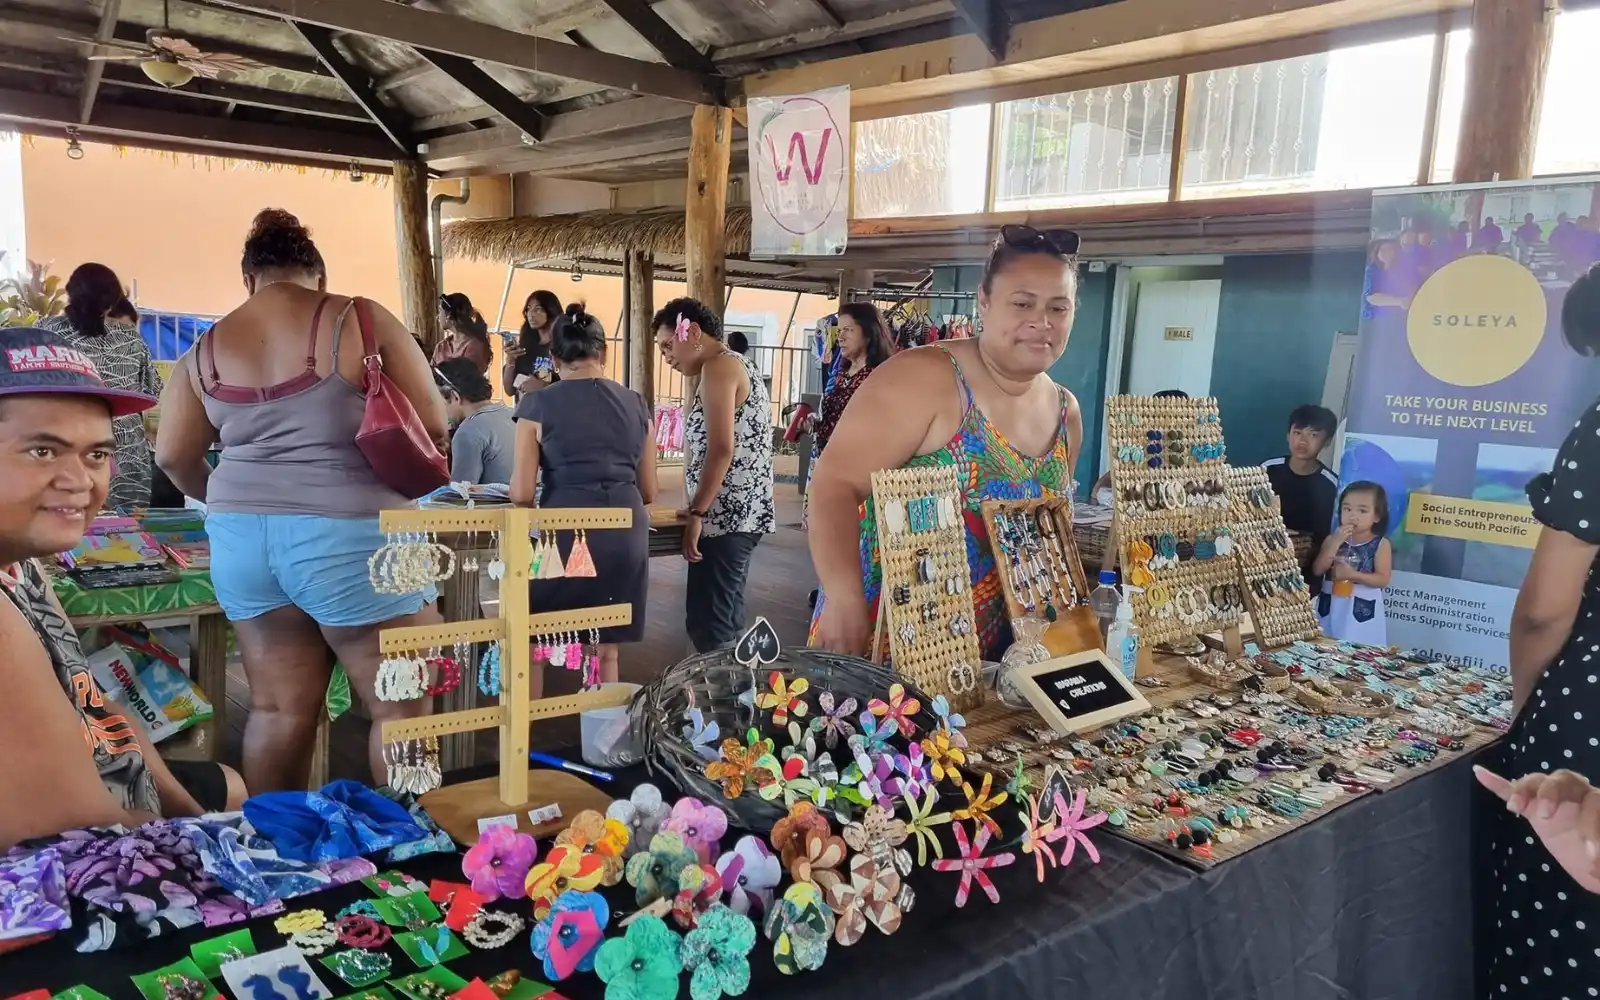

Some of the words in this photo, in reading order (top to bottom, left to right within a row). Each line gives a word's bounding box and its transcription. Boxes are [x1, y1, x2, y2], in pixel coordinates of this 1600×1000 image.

[1432, 314, 1517, 328] SOLEYA
[1384, 394, 1421, 409] TAKE
[1425, 397, 1468, 411] YOUR
[1472, 399, 1548, 416] BUSINESS
[1390, 411, 1410, 424] TO
[1414, 413, 1442, 426] THE
[1446, 415, 1487, 429] NEXT
[1490, 418, 1537, 433] LEVEL
[1420, 513, 1431, 523] in
[1433, 516, 1452, 526] the
[1454, 518, 1486, 531] South
[1488, 523, 1528, 536] Pacific
[1422, 502, 1456, 515] Social
[1458, 507, 1542, 525] Entrepreneurs
[1380, 586, 1410, 598] oject
[1413, 589, 1487, 610] Management
[1383, 597, 1409, 610] oject
[1411, 602, 1496, 625] Administration
[1384, 609, 1416, 623] siness
[1419, 615, 1463, 631] Support
[1465, 624, 1511, 640] Services
